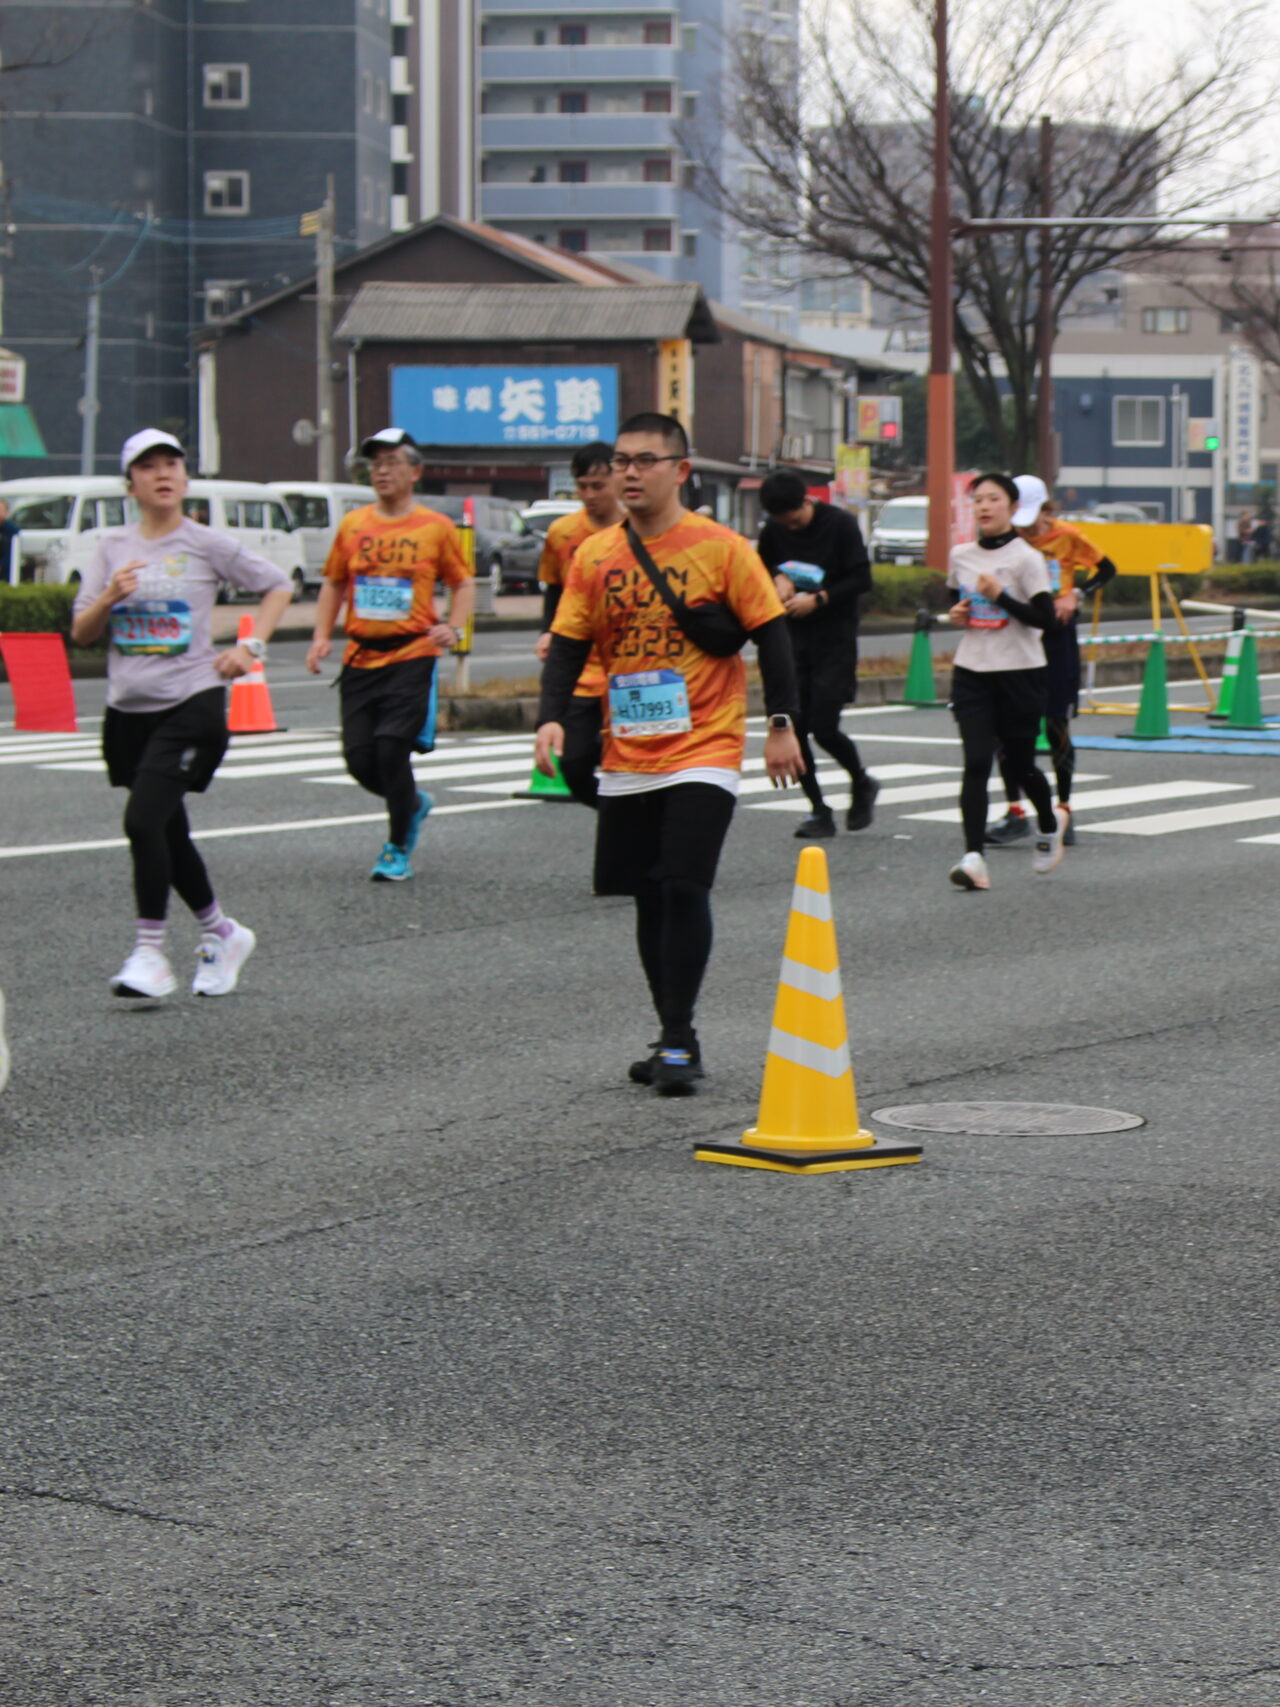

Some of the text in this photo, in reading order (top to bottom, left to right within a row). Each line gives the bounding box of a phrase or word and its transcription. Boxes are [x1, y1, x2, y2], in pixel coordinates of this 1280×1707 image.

[499, 377, 602, 422] 矢野
[358, 536, 418, 563] RUN
[604, 567, 688, 608] RUN
